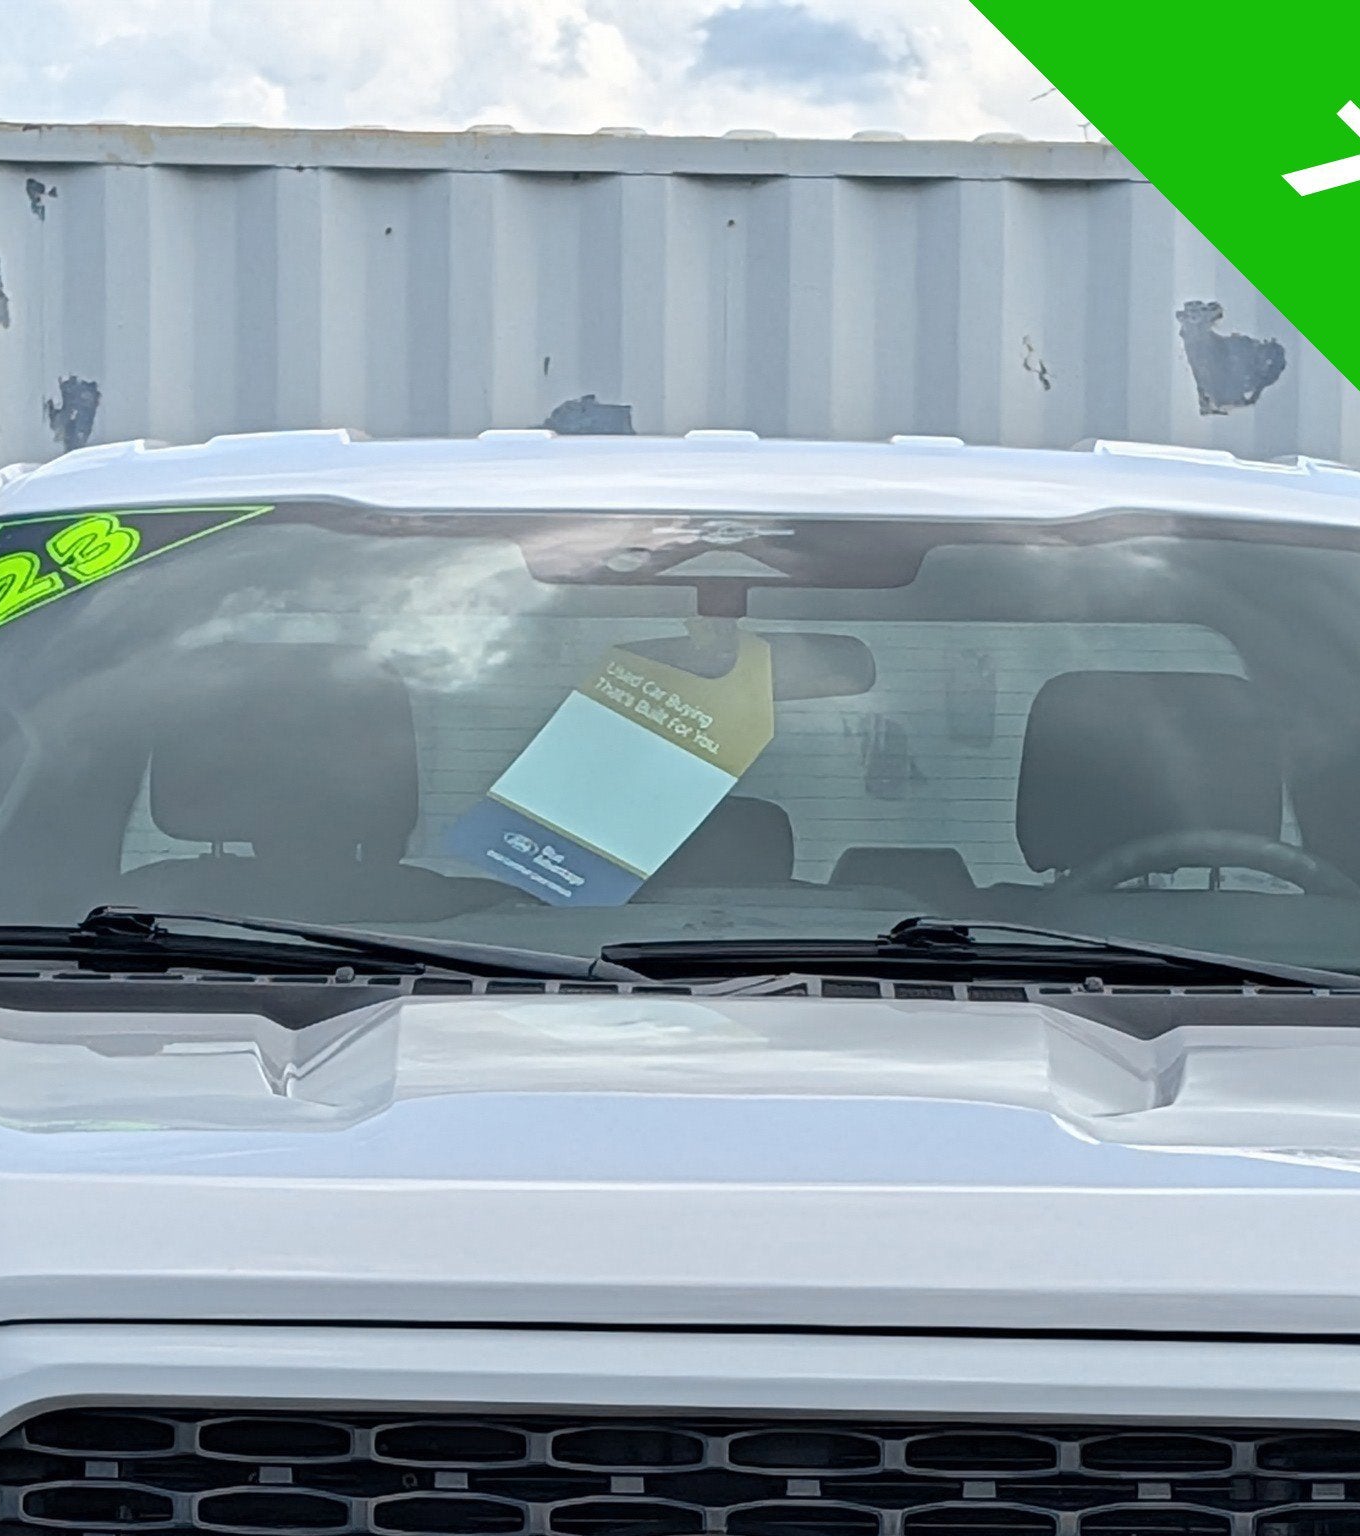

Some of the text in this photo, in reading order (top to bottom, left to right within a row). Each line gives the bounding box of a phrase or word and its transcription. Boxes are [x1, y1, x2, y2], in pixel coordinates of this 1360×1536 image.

[606, 661, 713, 729] Used Car Buying
[634, 699, 669, 725] Built
